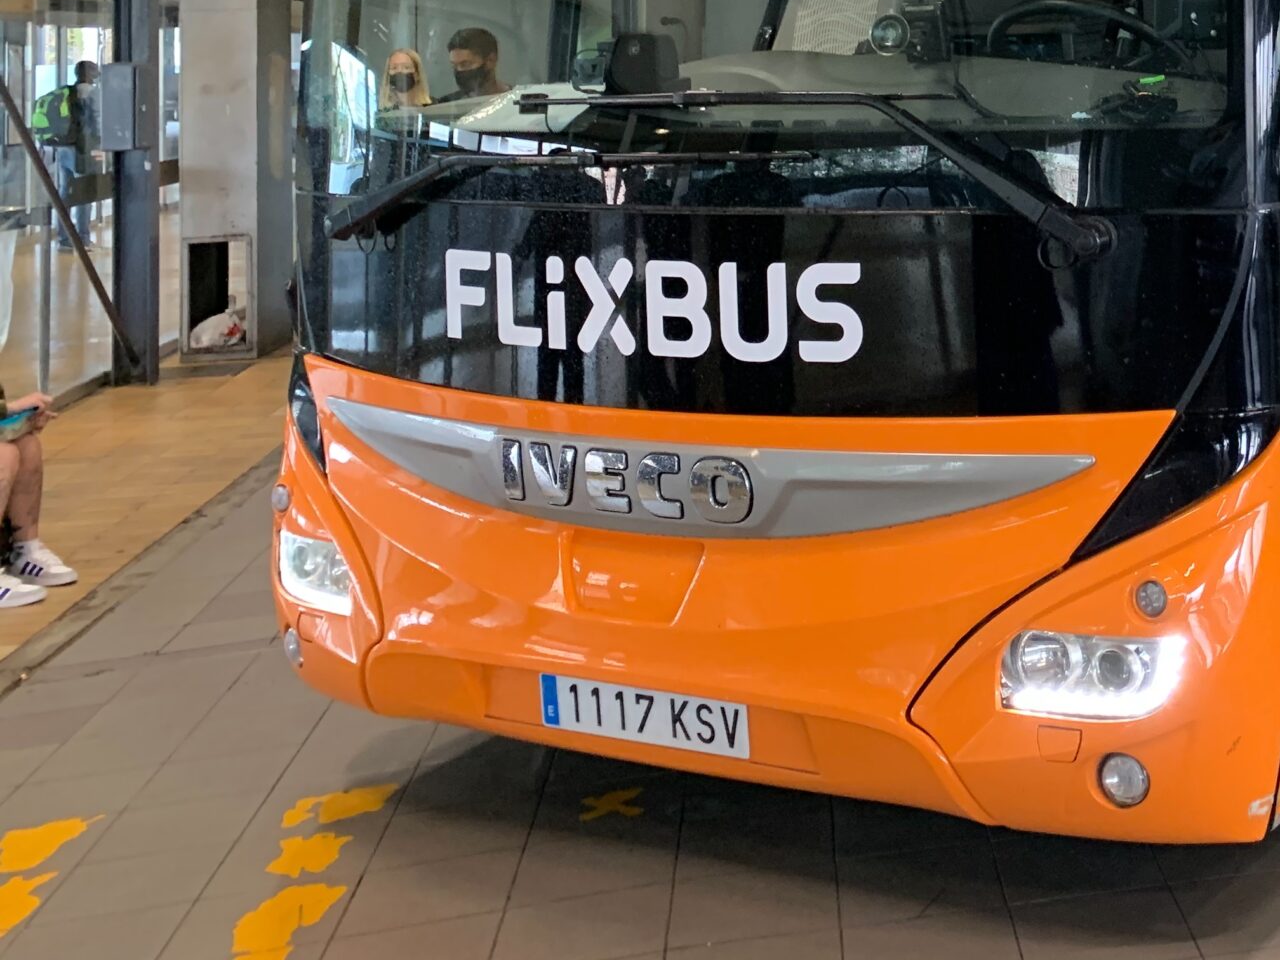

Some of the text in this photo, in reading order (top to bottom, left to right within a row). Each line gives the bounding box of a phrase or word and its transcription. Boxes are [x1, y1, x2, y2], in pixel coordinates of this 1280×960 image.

[503, 438, 754, 524] IVECO
[569, 683, 739, 749] 1117 KSV
